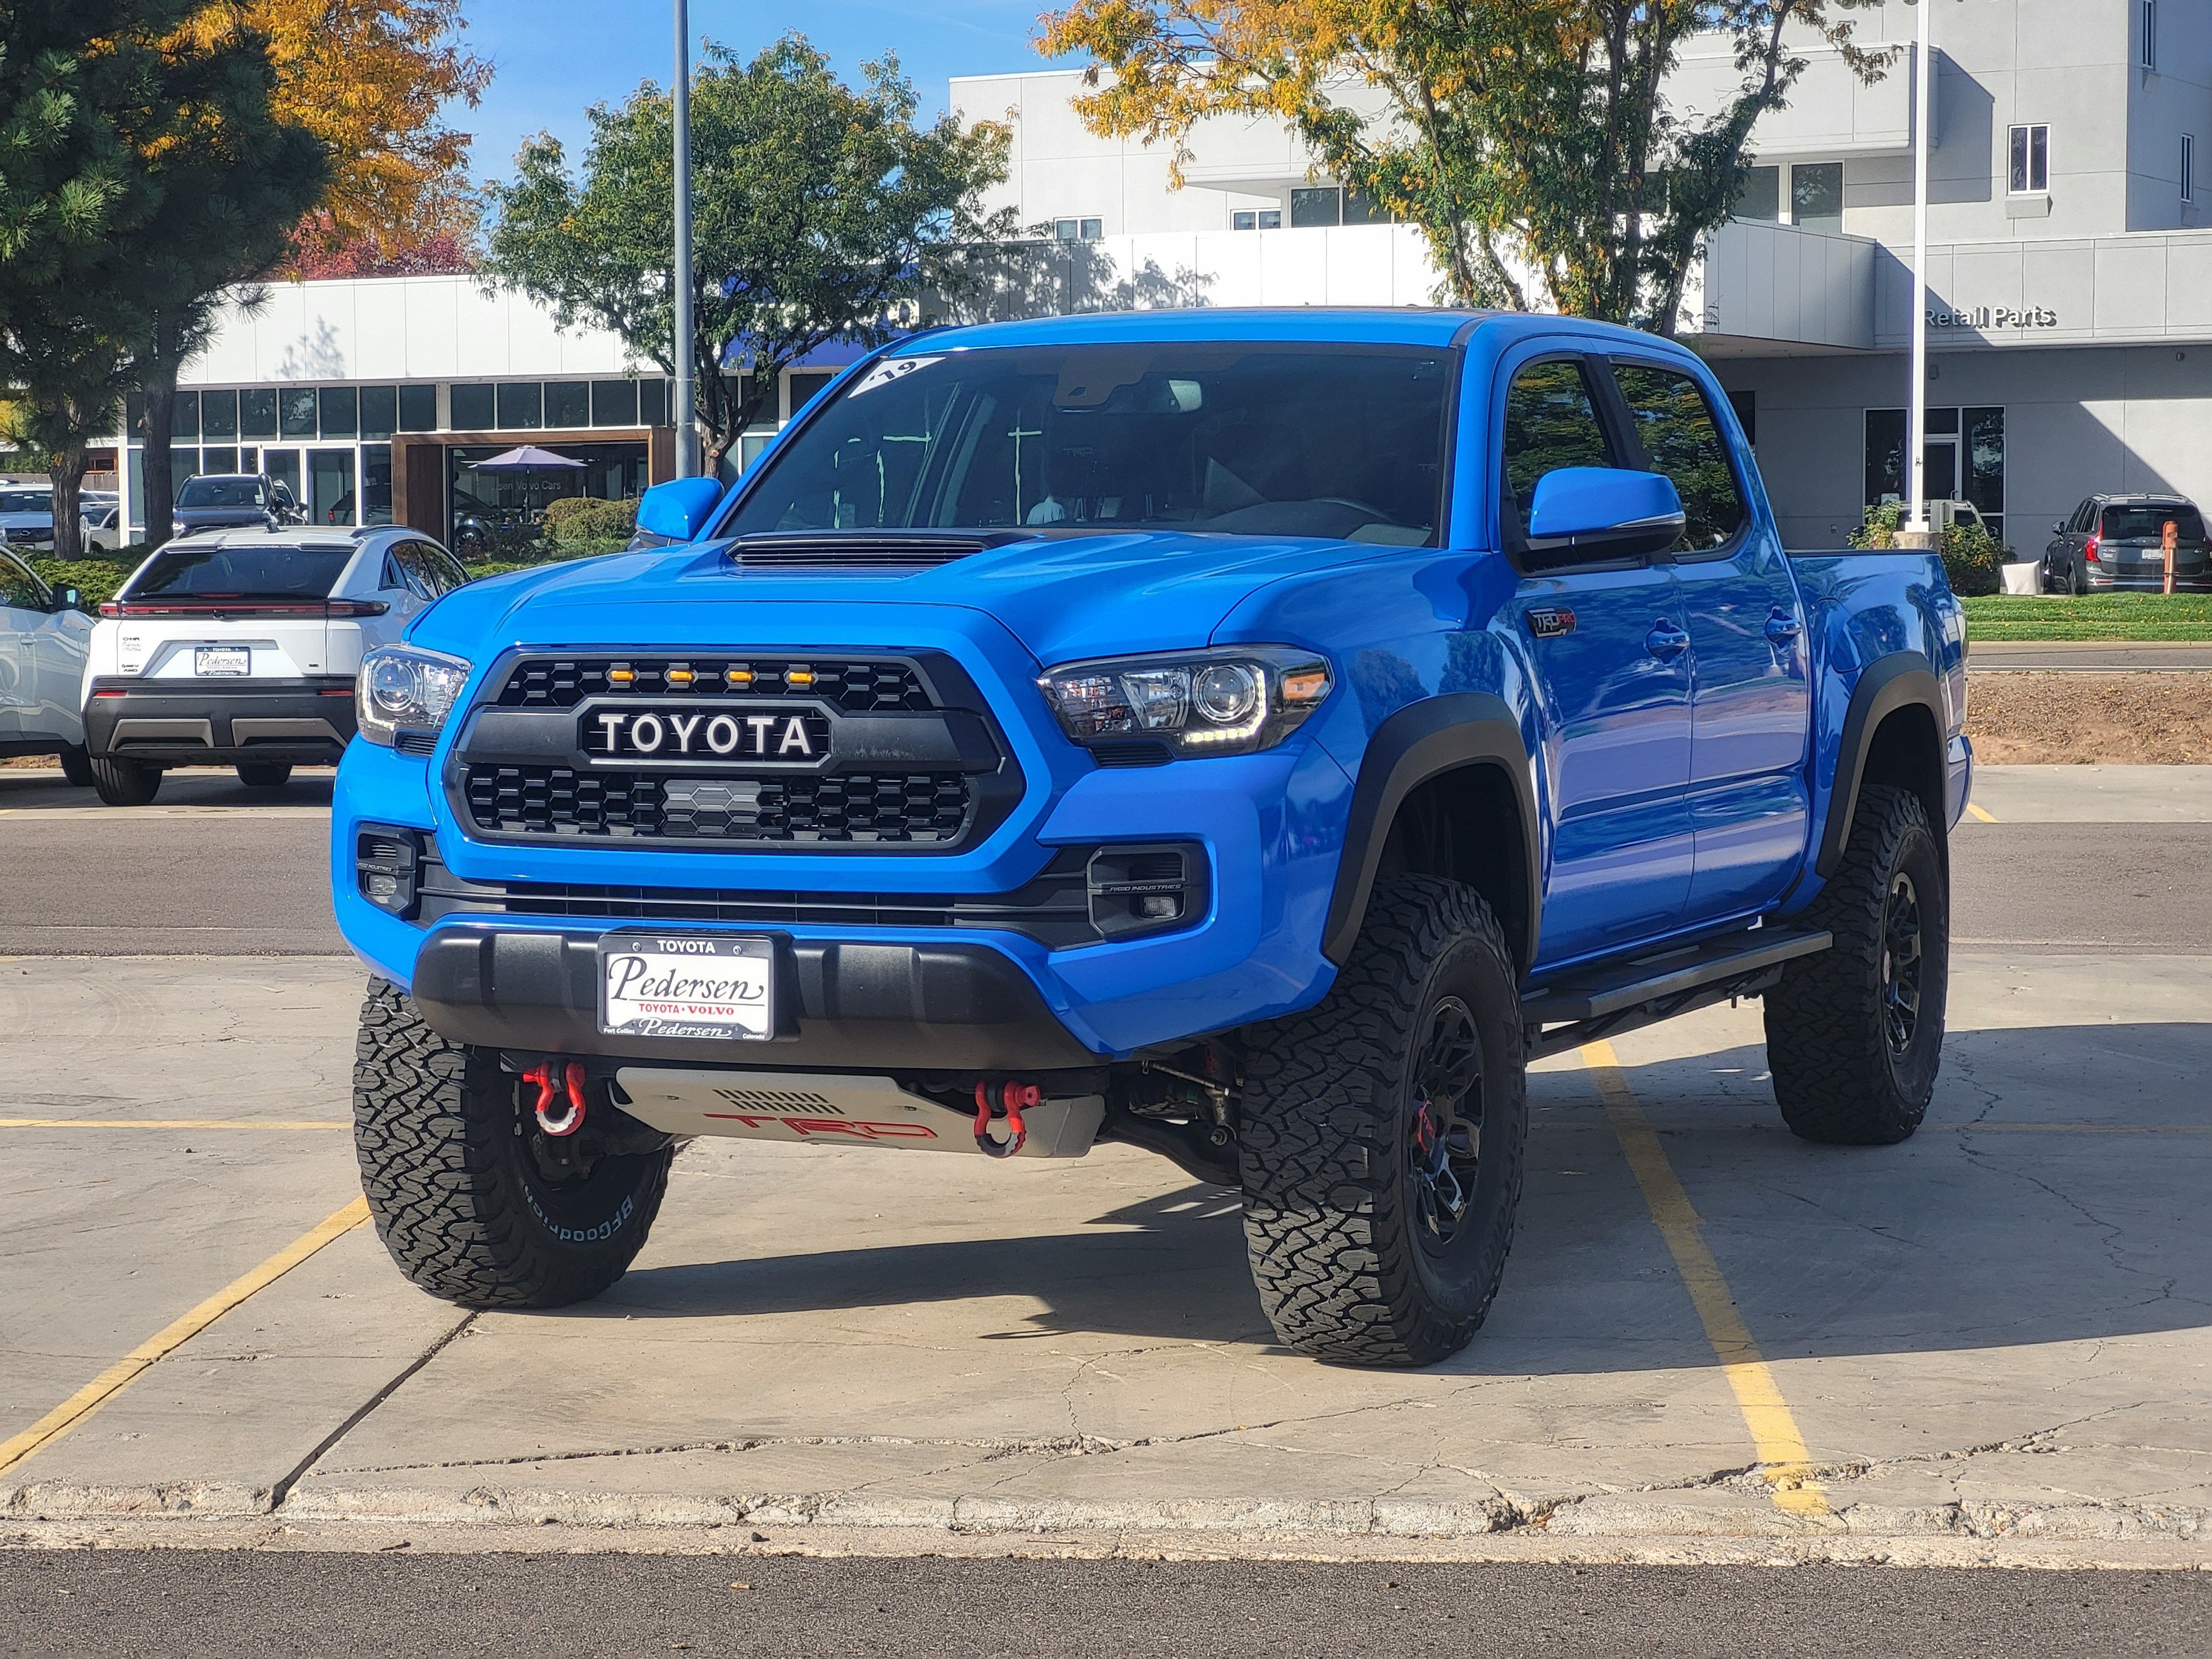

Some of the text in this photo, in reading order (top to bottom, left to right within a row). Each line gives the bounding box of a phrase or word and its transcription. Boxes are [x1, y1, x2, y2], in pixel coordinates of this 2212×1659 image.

[1924, 305, 2052, 326] Retail Parts
[542, 480, 561, 490] Cars
[1557, 613, 1576, 623] PRO
[197, 653, 247, 666] Pedersen
[598, 713, 816, 756] TOYOTA
[657, 940, 716, 954] TOYOTA
[608, 956, 764, 1000] Pedersen
[639, 1003, 734, 1015] TOYOTA VOLVO
[638, 1017, 732, 1037] Pedersen
[703, 1113, 938, 1139] TRD
